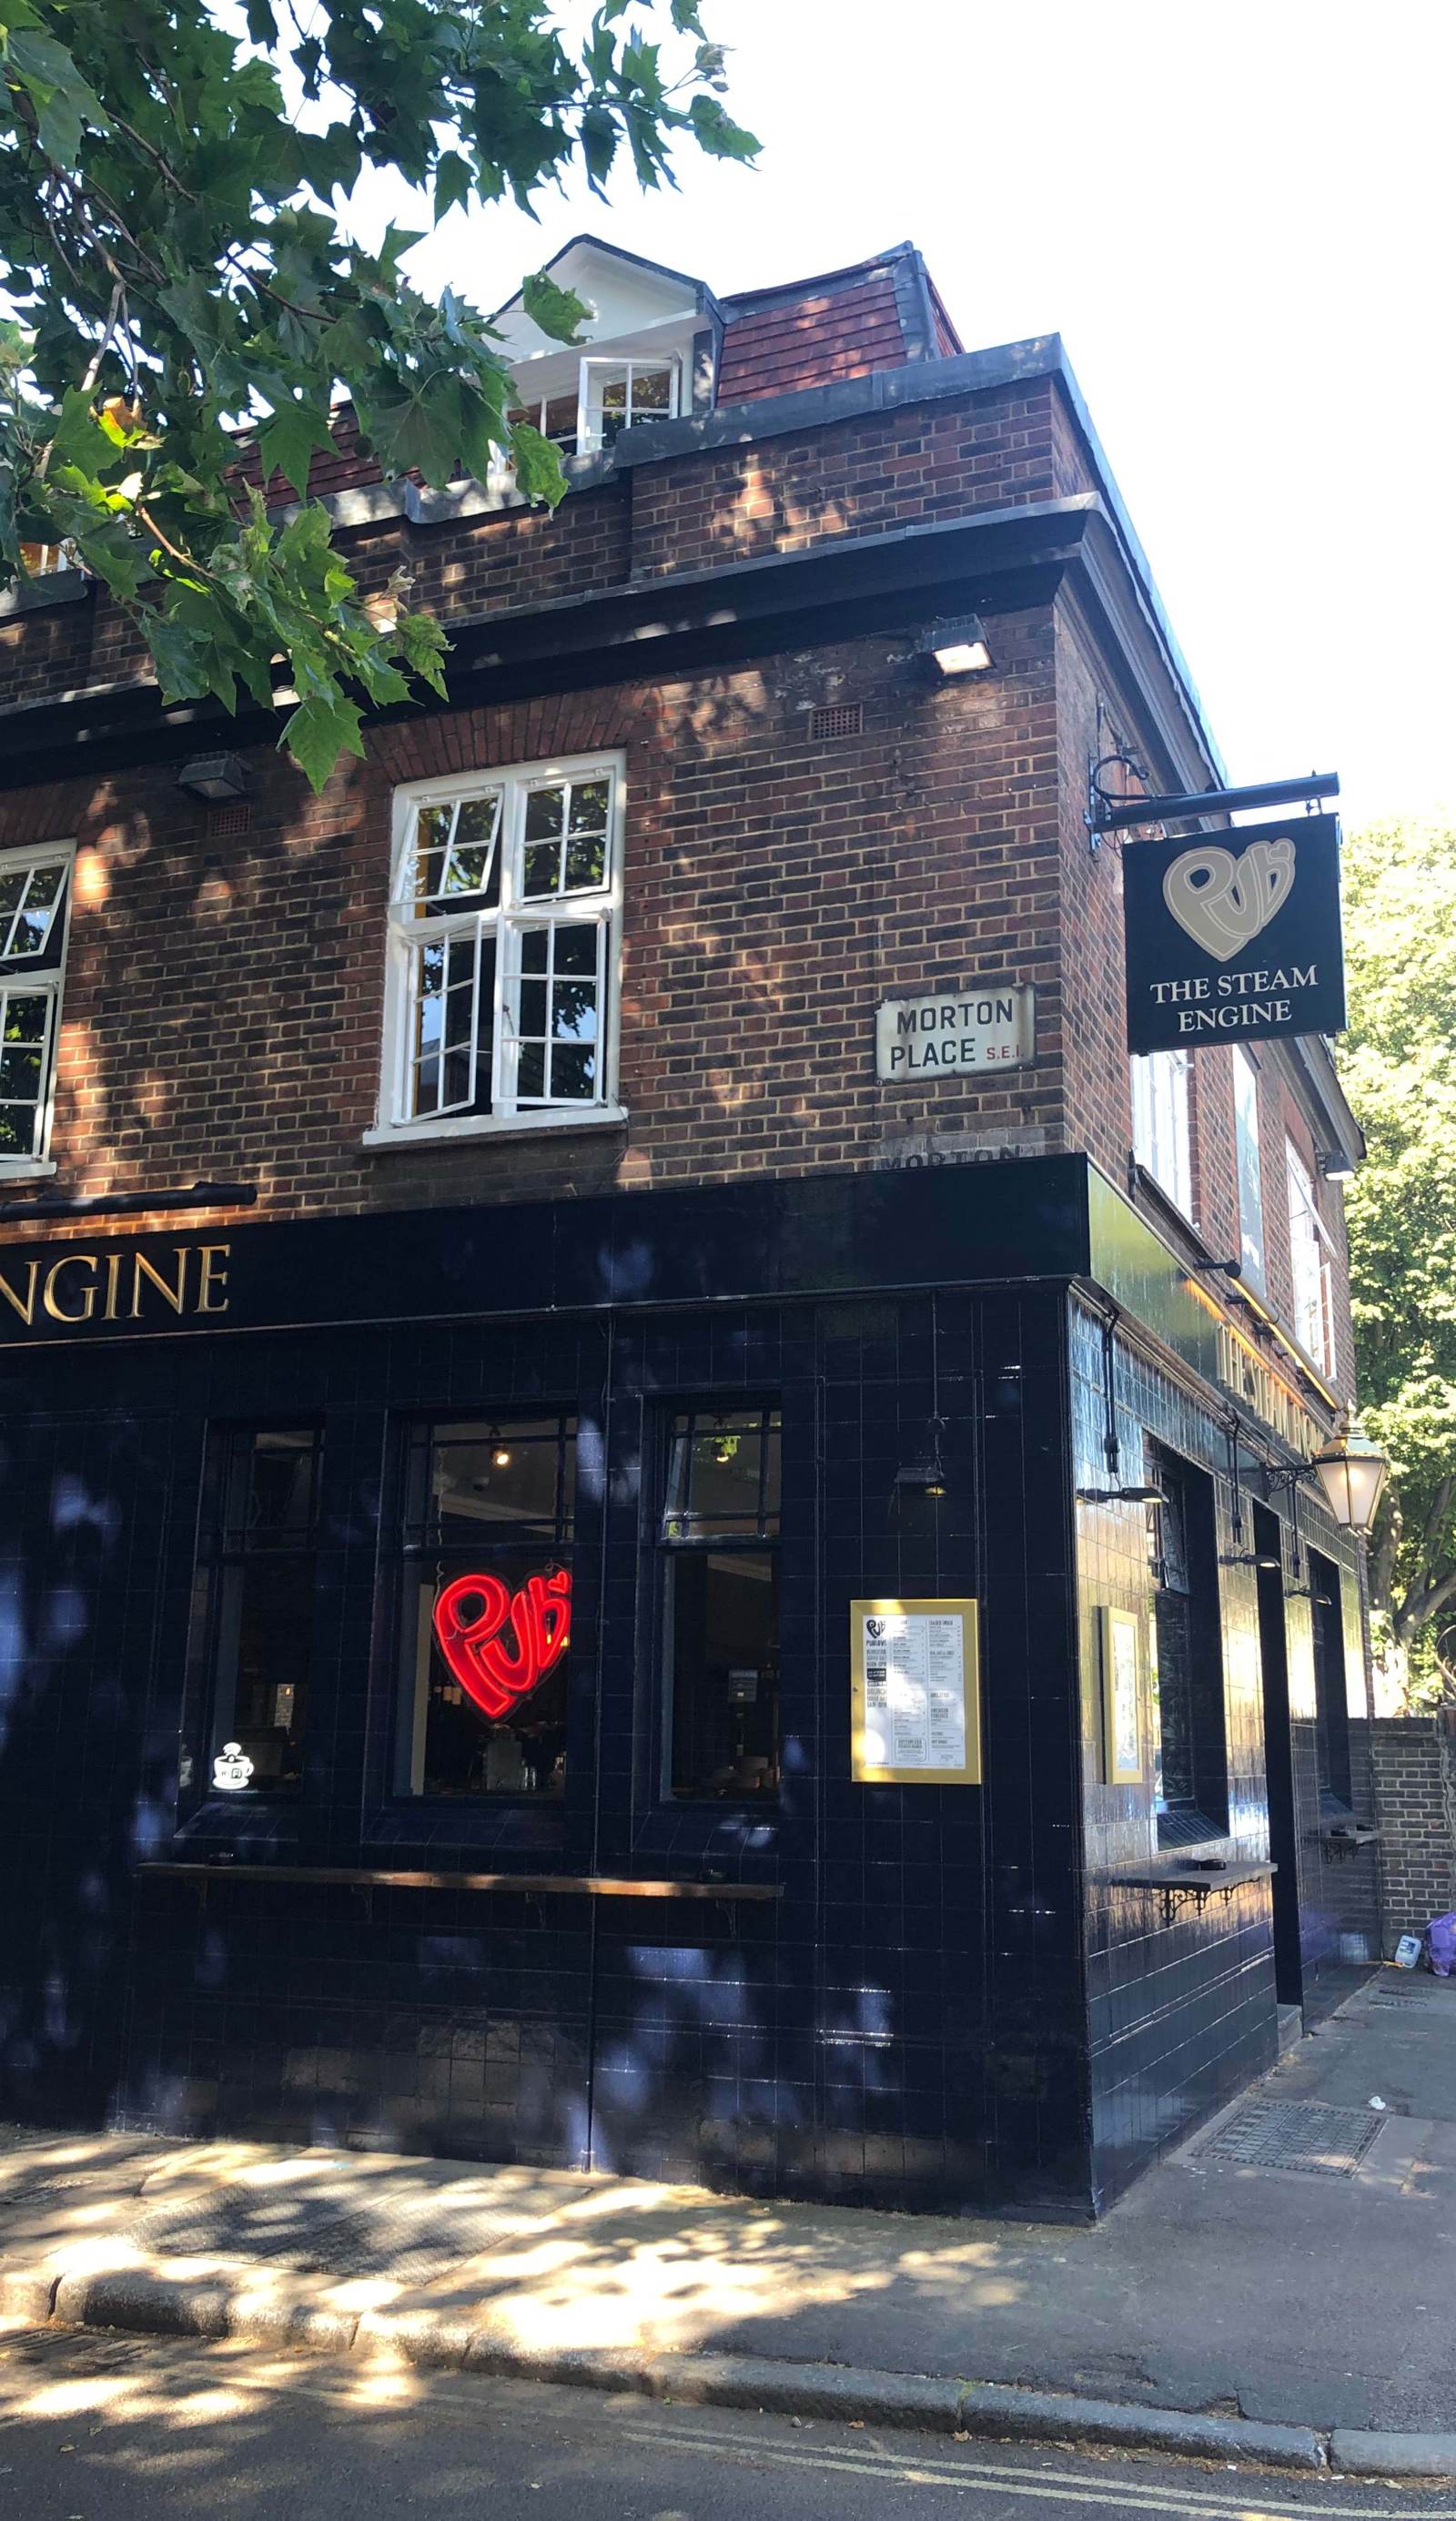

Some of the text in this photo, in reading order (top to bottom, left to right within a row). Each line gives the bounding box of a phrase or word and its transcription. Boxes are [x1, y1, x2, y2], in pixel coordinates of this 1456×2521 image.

[1150, 965, 1319, 1004] THE STEAM
[896, 998, 1013, 1035] MORTON
[1178, 999, 1292, 1032] ENGINE
[891, 1038, 976, 1070] PLACE
